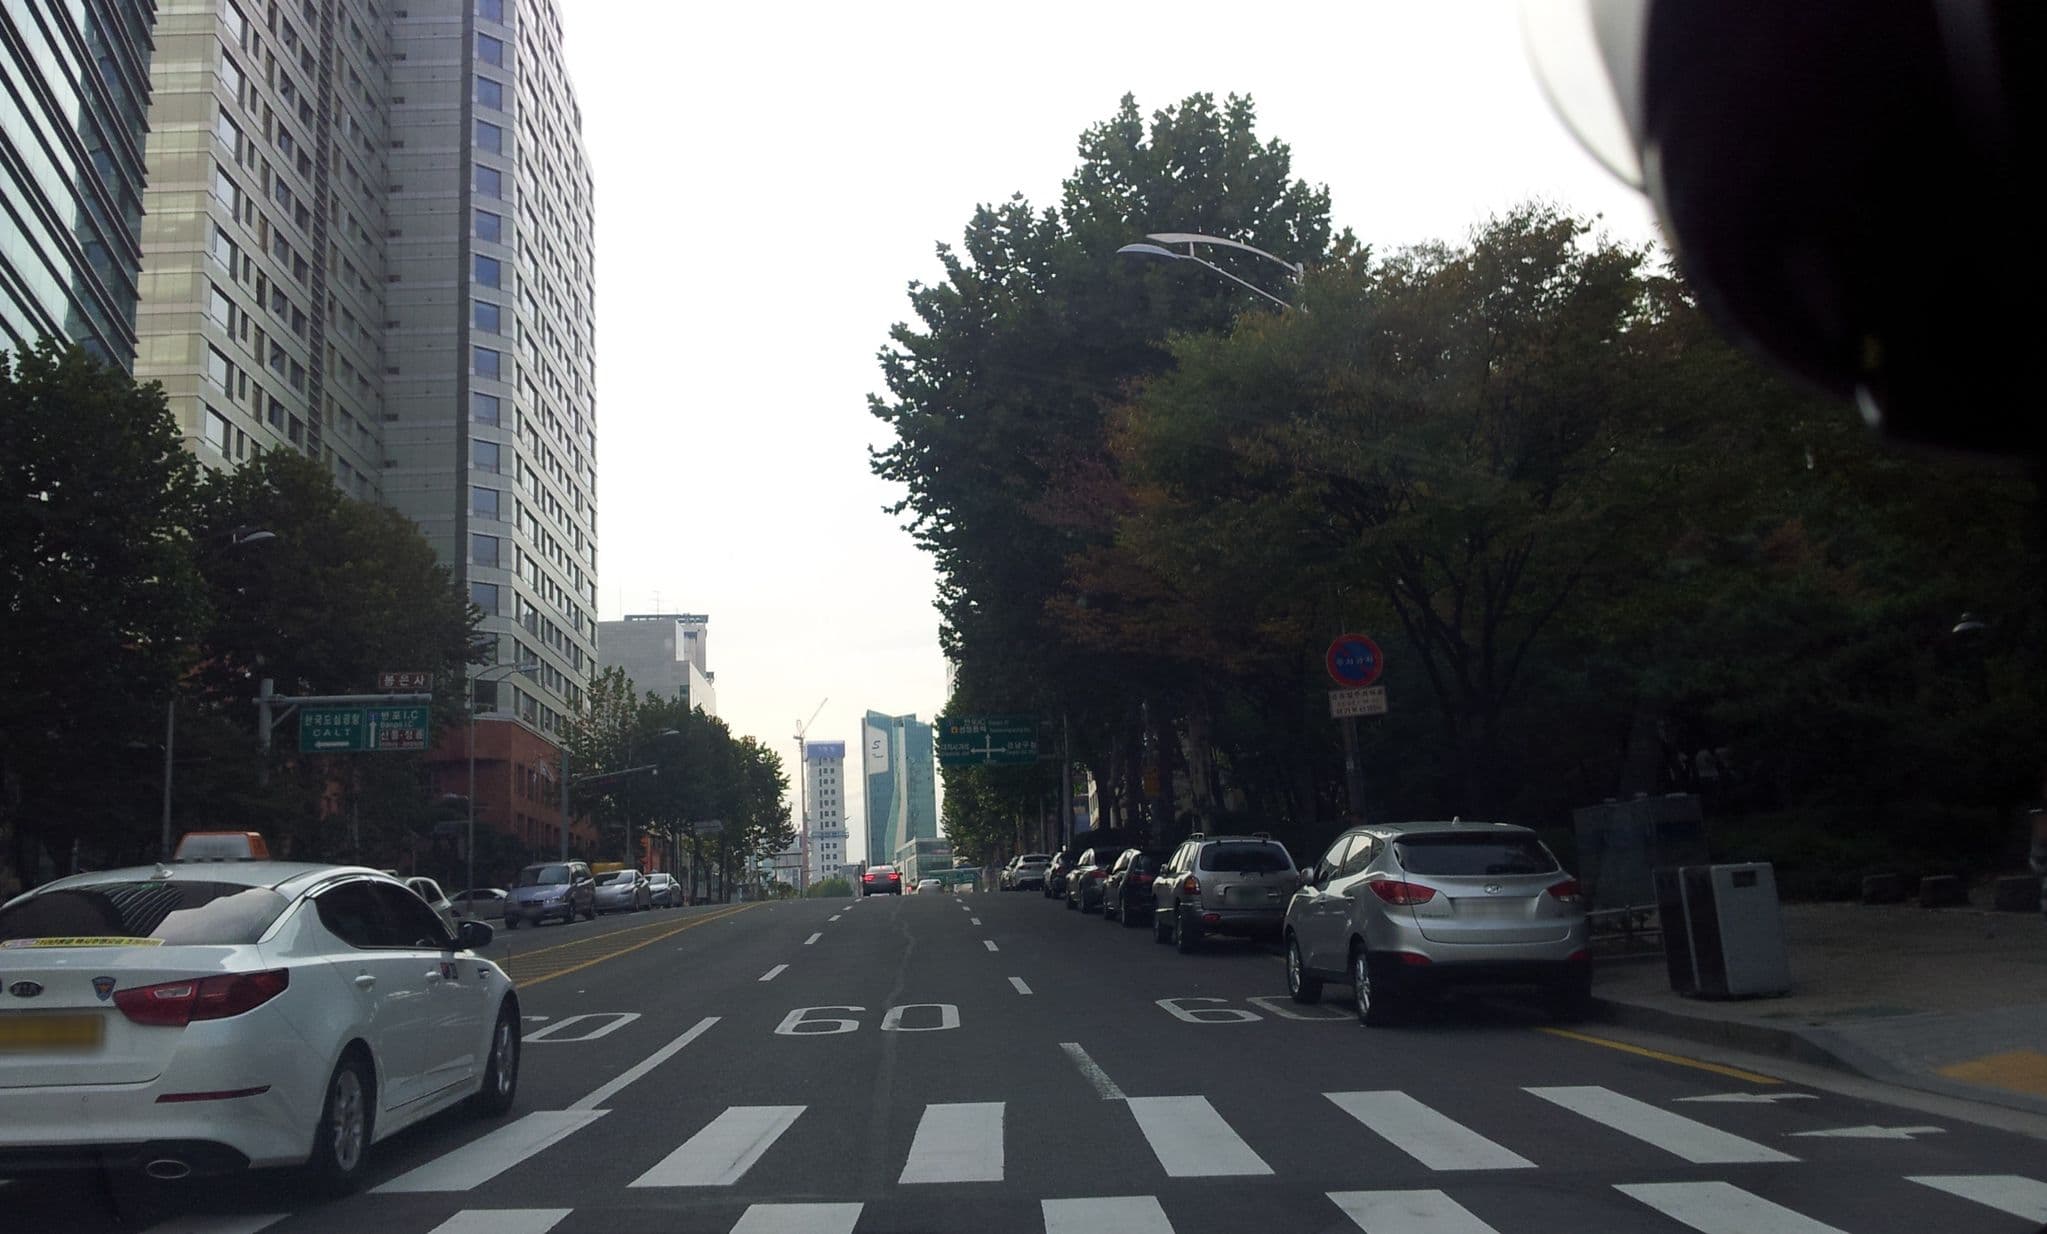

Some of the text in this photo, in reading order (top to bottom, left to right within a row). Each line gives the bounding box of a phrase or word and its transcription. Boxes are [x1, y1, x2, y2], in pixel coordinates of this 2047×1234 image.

[384, 674, 425, 687] 봉은사
[312, 728, 351, 737] CALT
[774, 1004, 961, 1035] 60
